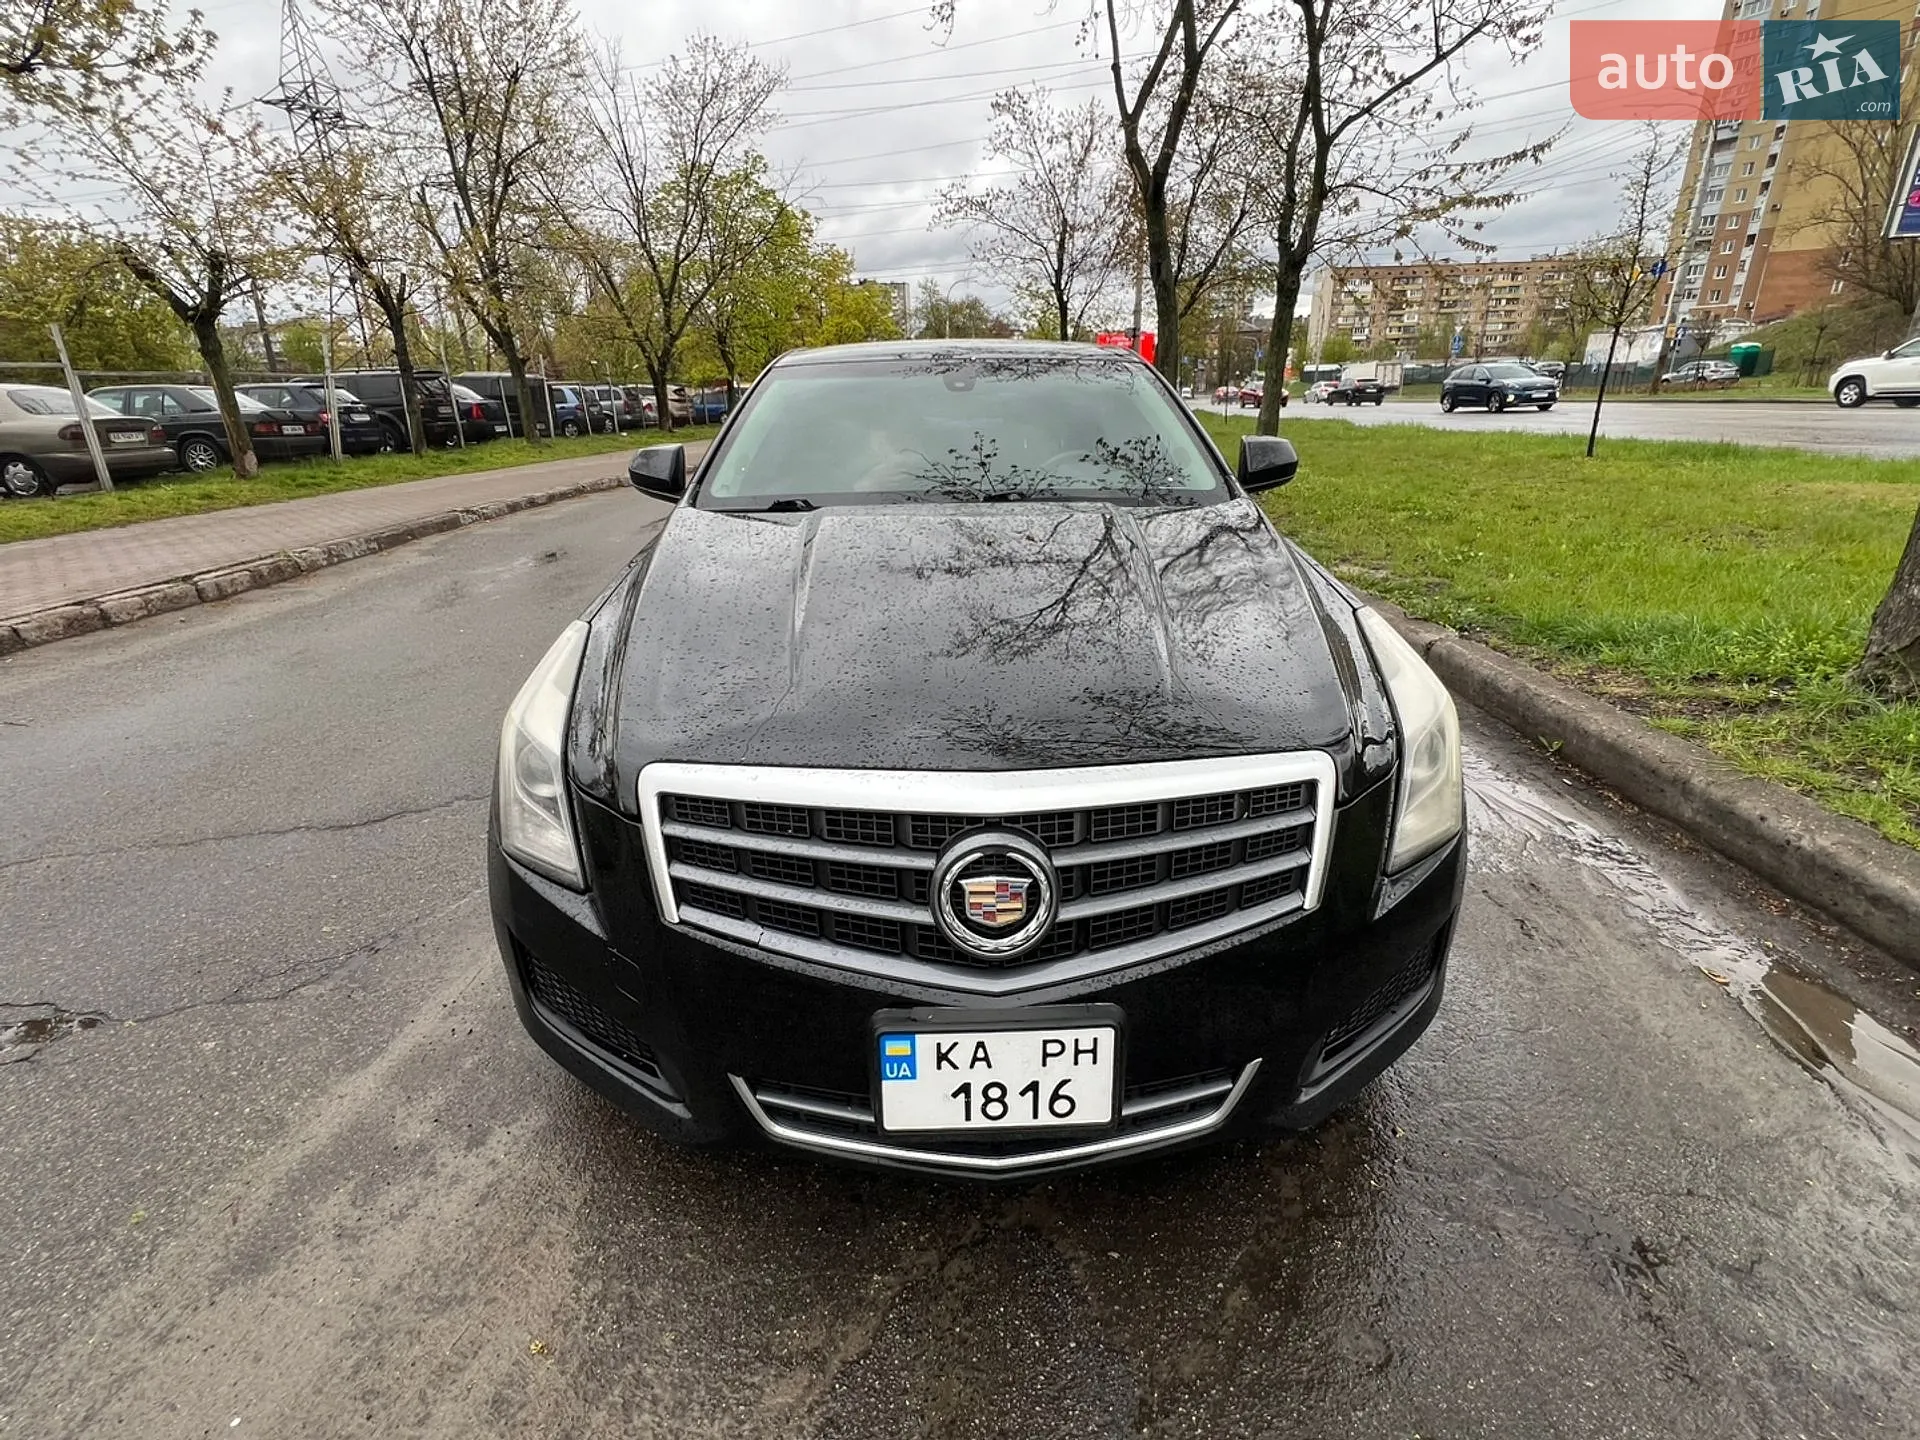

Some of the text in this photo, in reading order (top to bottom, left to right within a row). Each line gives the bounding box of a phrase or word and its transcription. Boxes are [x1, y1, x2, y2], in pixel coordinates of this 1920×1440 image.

[885, 1062, 912, 1079] UA
[935, 1037, 1099, 1071] KA PH
[950, 1078, 1077, 1122] 1816
